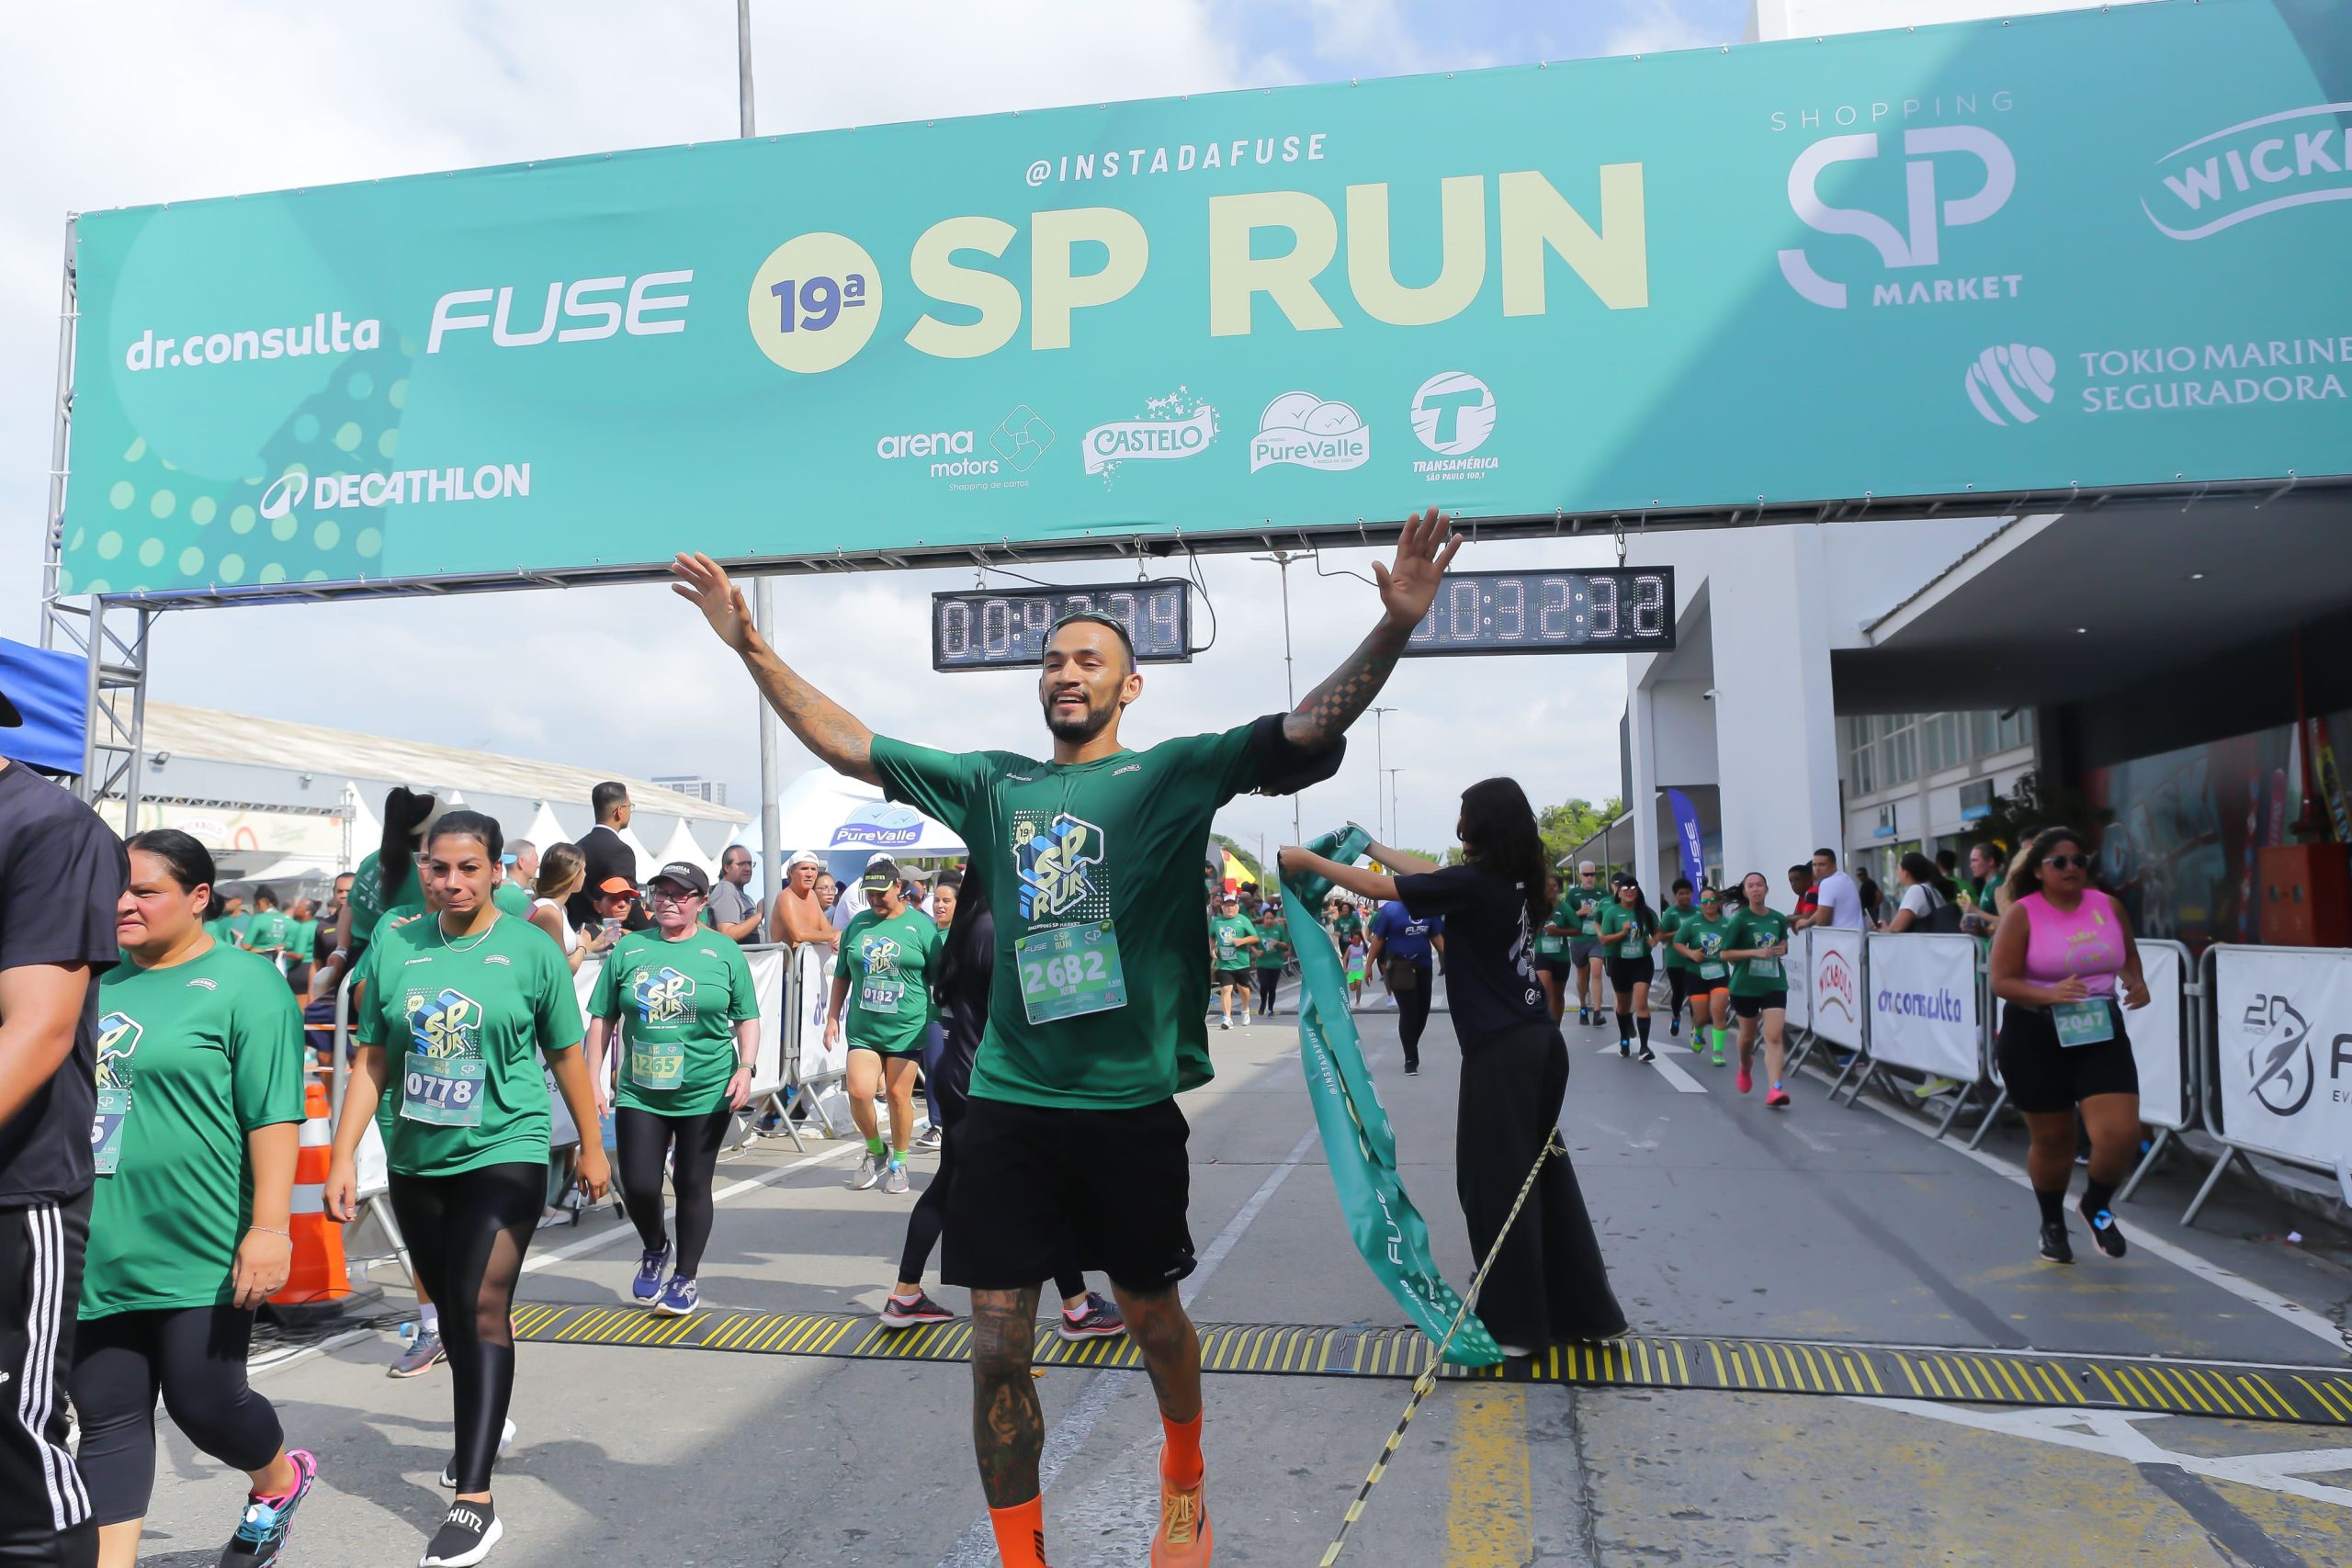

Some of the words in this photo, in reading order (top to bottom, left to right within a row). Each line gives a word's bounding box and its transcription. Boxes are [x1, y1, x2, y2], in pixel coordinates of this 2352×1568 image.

[1770, 91, 2014, 131] SHOPPING
[1025, 134, 1327, 187] @INSTADAFUSE
[2162, 127, 2352, 210] WICK
[904, 206, 1149, 359] SP
[1208, 161, 1649, 337] RUN
[1872, 274, 2024, 307] MARKET
[426, 269, 695, 355] FUSE
[126, 310, 380, 372] dr.consulta
[2079, 345, 2197, 378] TOKIO
[2202, 335, 2352, 370] MARINE
[2082, 373, 2347, 413] SEGURADORA
[876, 430, 974, 460] arena
[1093, 425, 1204, 457] CASTELO
[1256, 438, 1364, 462] PureValle
[930, 458, 1000, 479] motors
[1412, 457, 1499, 473] TRANSAMÉRICA
[1425, 472, 1441, 482] SÃO
[1442, 472, 1465, 481] PAULO
[313, 462, 531, 512] DECATHLON
[836, 829, 917, 841] PureValle
[1034, 825, 1088, 890] SP
[1023, 950, 1108, 994] 2682
[865, 987, 893, 1002] 0182
[2058, 1010, 2105, 1032] 2047
[407, 1072, 472, 1103] 0778
[442, 1507, 483, 1534] HUTZ
